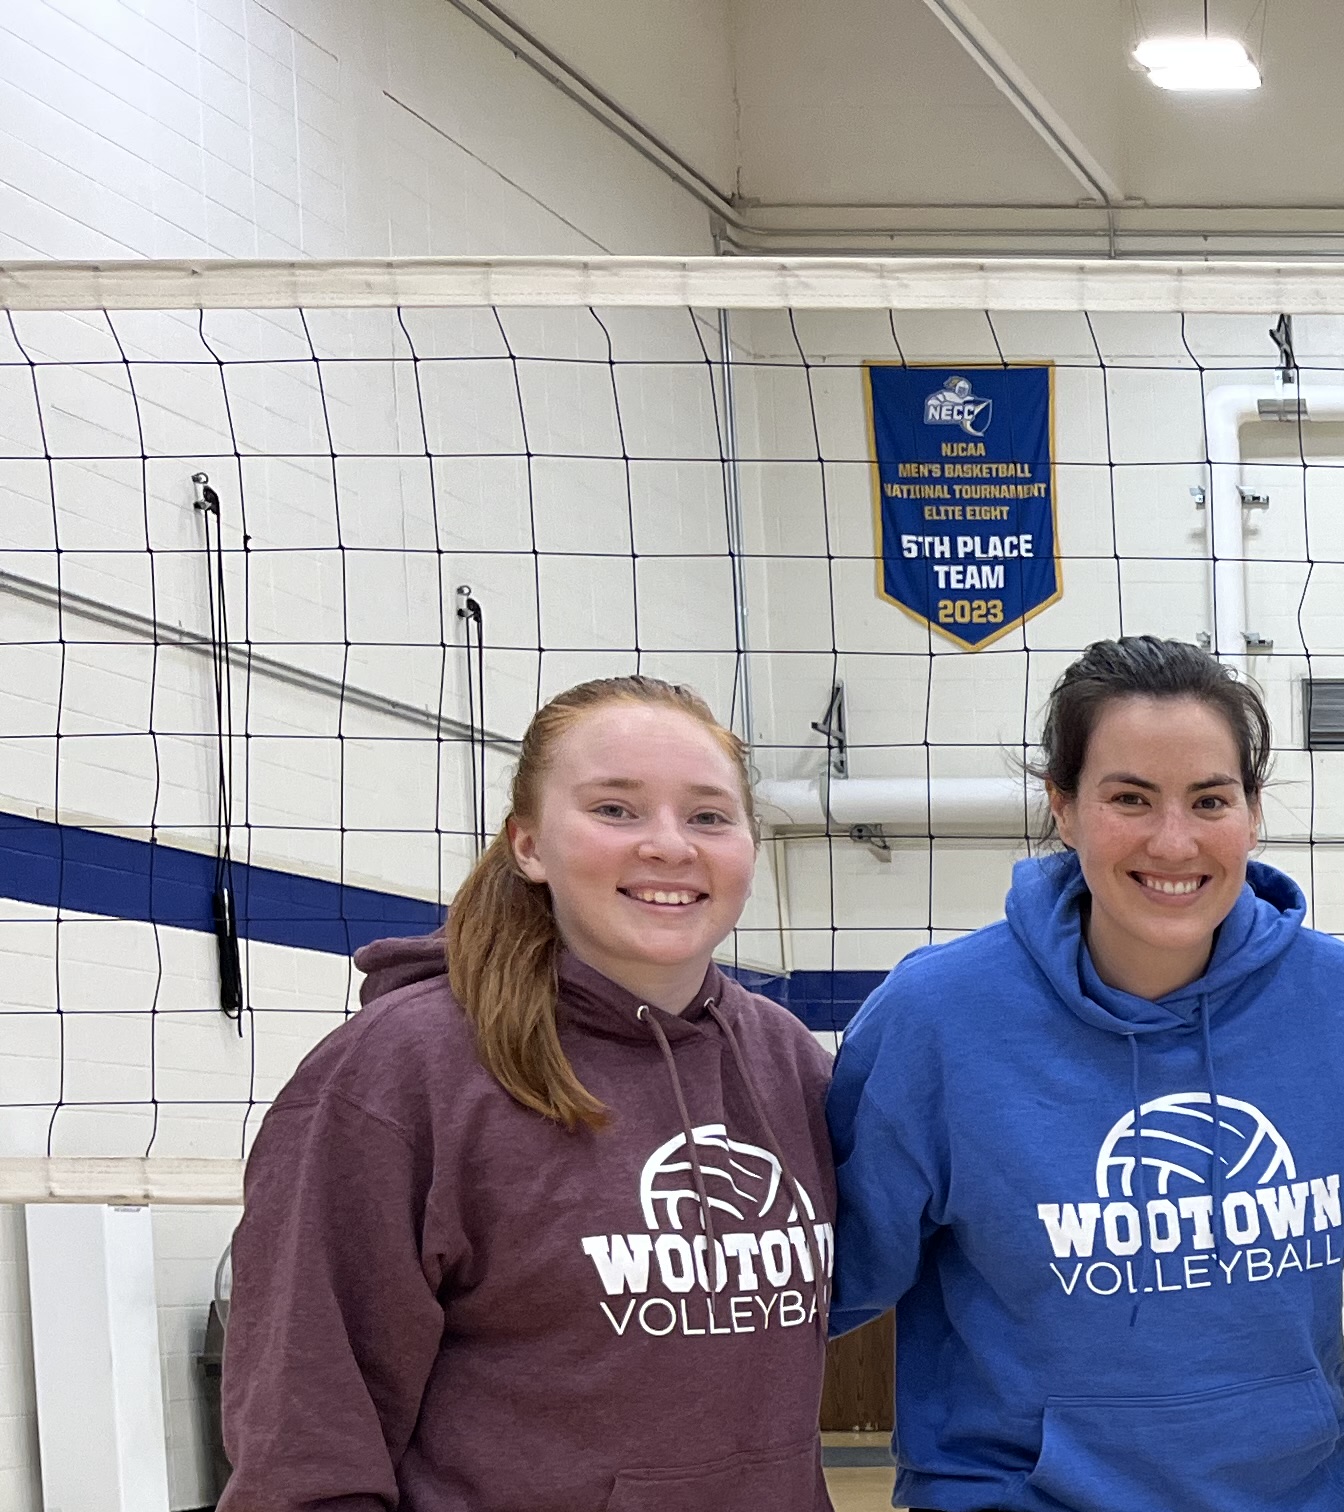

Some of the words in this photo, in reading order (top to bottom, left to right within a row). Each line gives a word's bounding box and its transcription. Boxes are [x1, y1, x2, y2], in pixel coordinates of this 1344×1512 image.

[928, 404, 975, 421] NECC
[941, 442, 986, 457] NJCAA
[898, 462, 942, 478] MEN'S
[944, 462, 1033, 478] BASKETBALL
[952, 482, 1047, 499] TOURNAMENT
[923, 505, 964, 520] ELITE
[965, 506, 1010, 521] EIGHT
[900, 533, 950, 559] 5TH
[957, 533, 1034, 559] PLACE
[933, 564, 1005, 590] TEAM
[937, 599, 1004, 624] 2023
[1036, 1173, 1343, 1259] WOOTOWN
[1049, 1234, 1341, 1295] VOLLEYBALL
